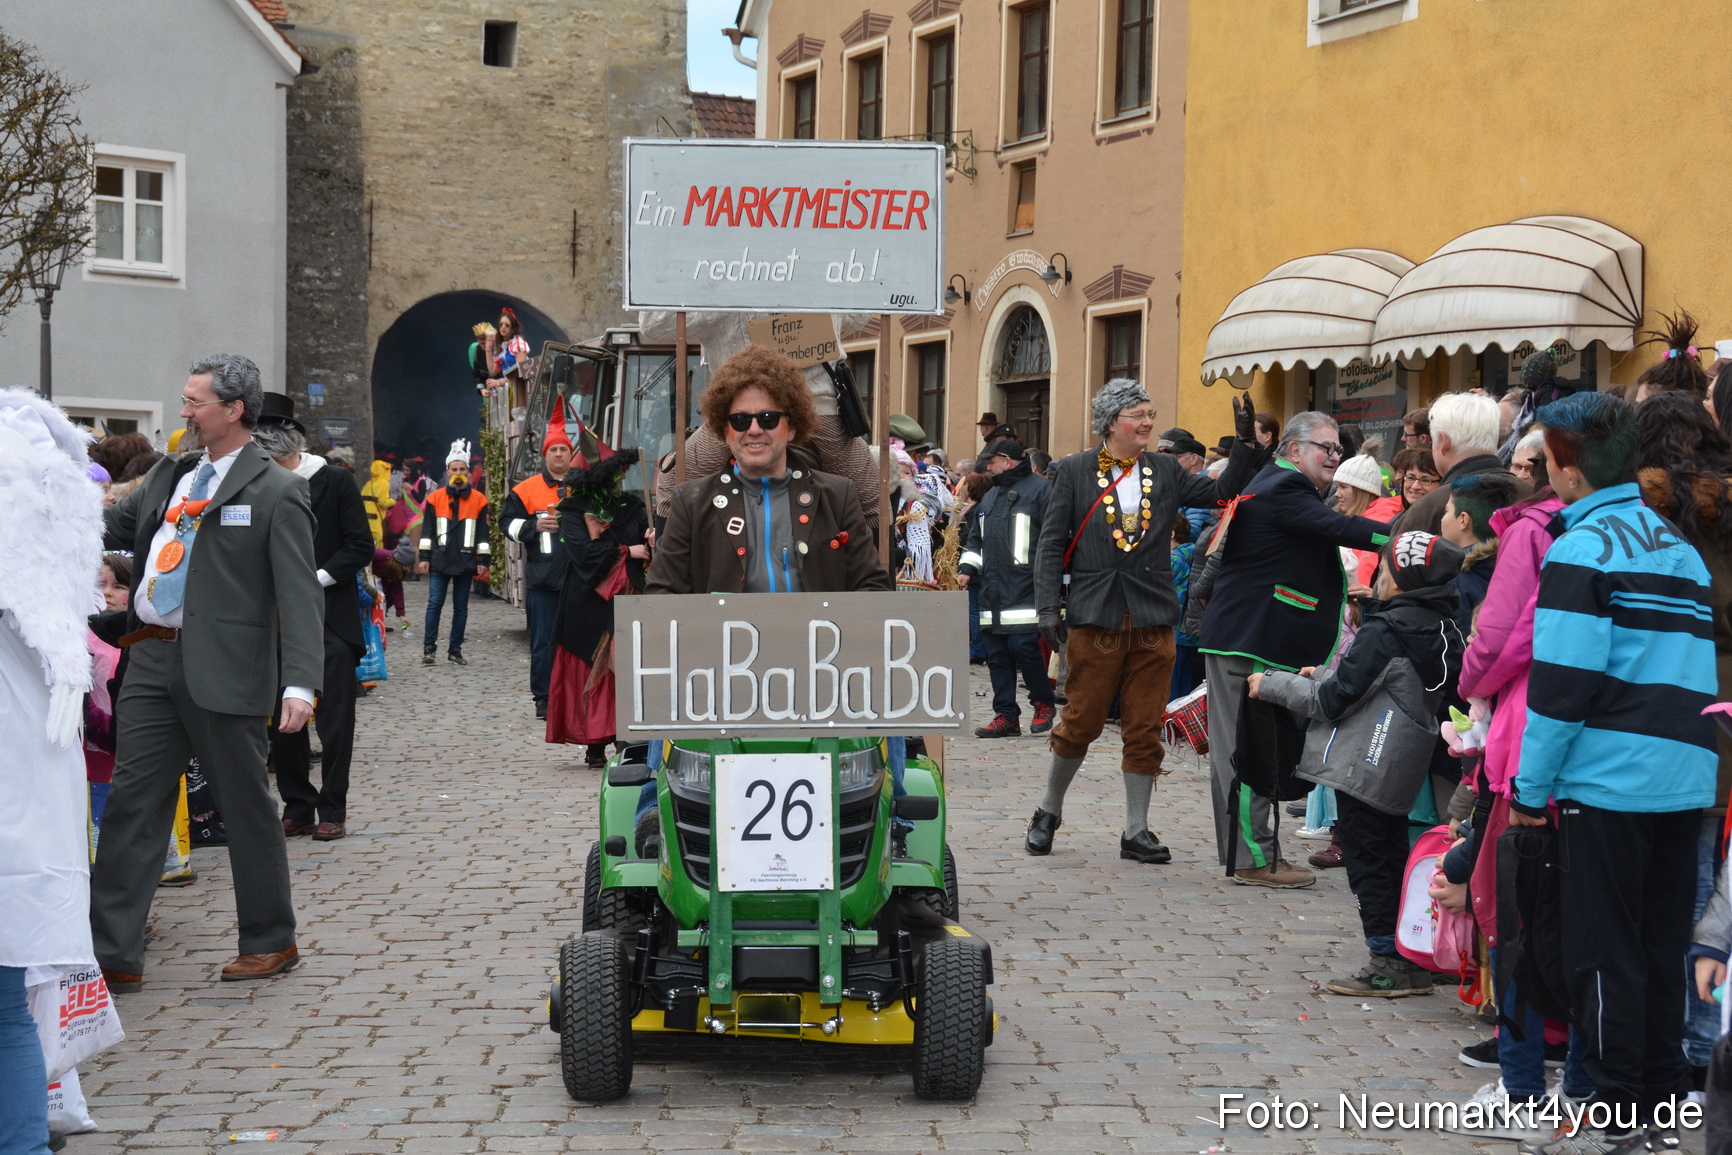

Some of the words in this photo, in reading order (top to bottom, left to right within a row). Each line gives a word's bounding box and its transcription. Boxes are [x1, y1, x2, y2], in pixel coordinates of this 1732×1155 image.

[635, 190, 676, 226] Ein
[693, 247, 800, 282] rechnet
[771, 318, 804, 336] Franz
[1367, 723, 1382, 757] DIVISION
[740, 778, 815, 842] 26
